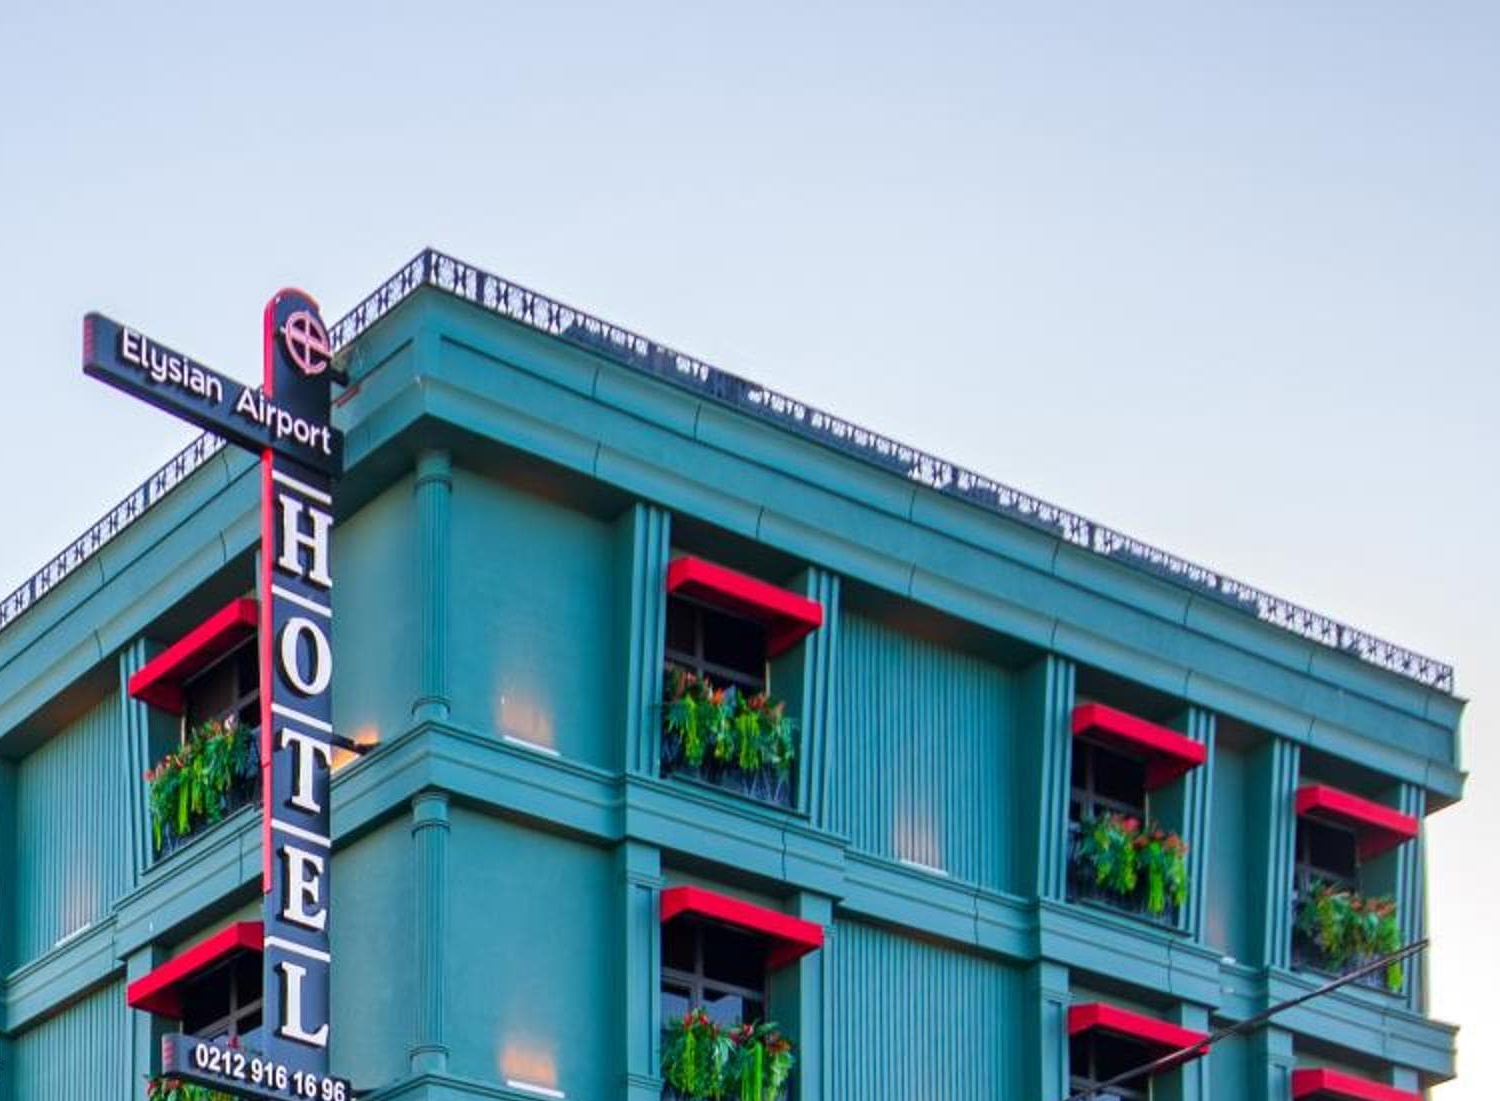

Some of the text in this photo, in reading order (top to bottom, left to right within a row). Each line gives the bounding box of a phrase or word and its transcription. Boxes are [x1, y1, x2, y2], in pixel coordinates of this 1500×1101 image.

[121, 326, 332, 455] Elysian Airport
[278, 493, 333, 1047] HOTEL
[195, 1043, 245, 1079] 0212
[251, 1057, 288, 1089] 916
[293, 1070, 317, 1097] 16
